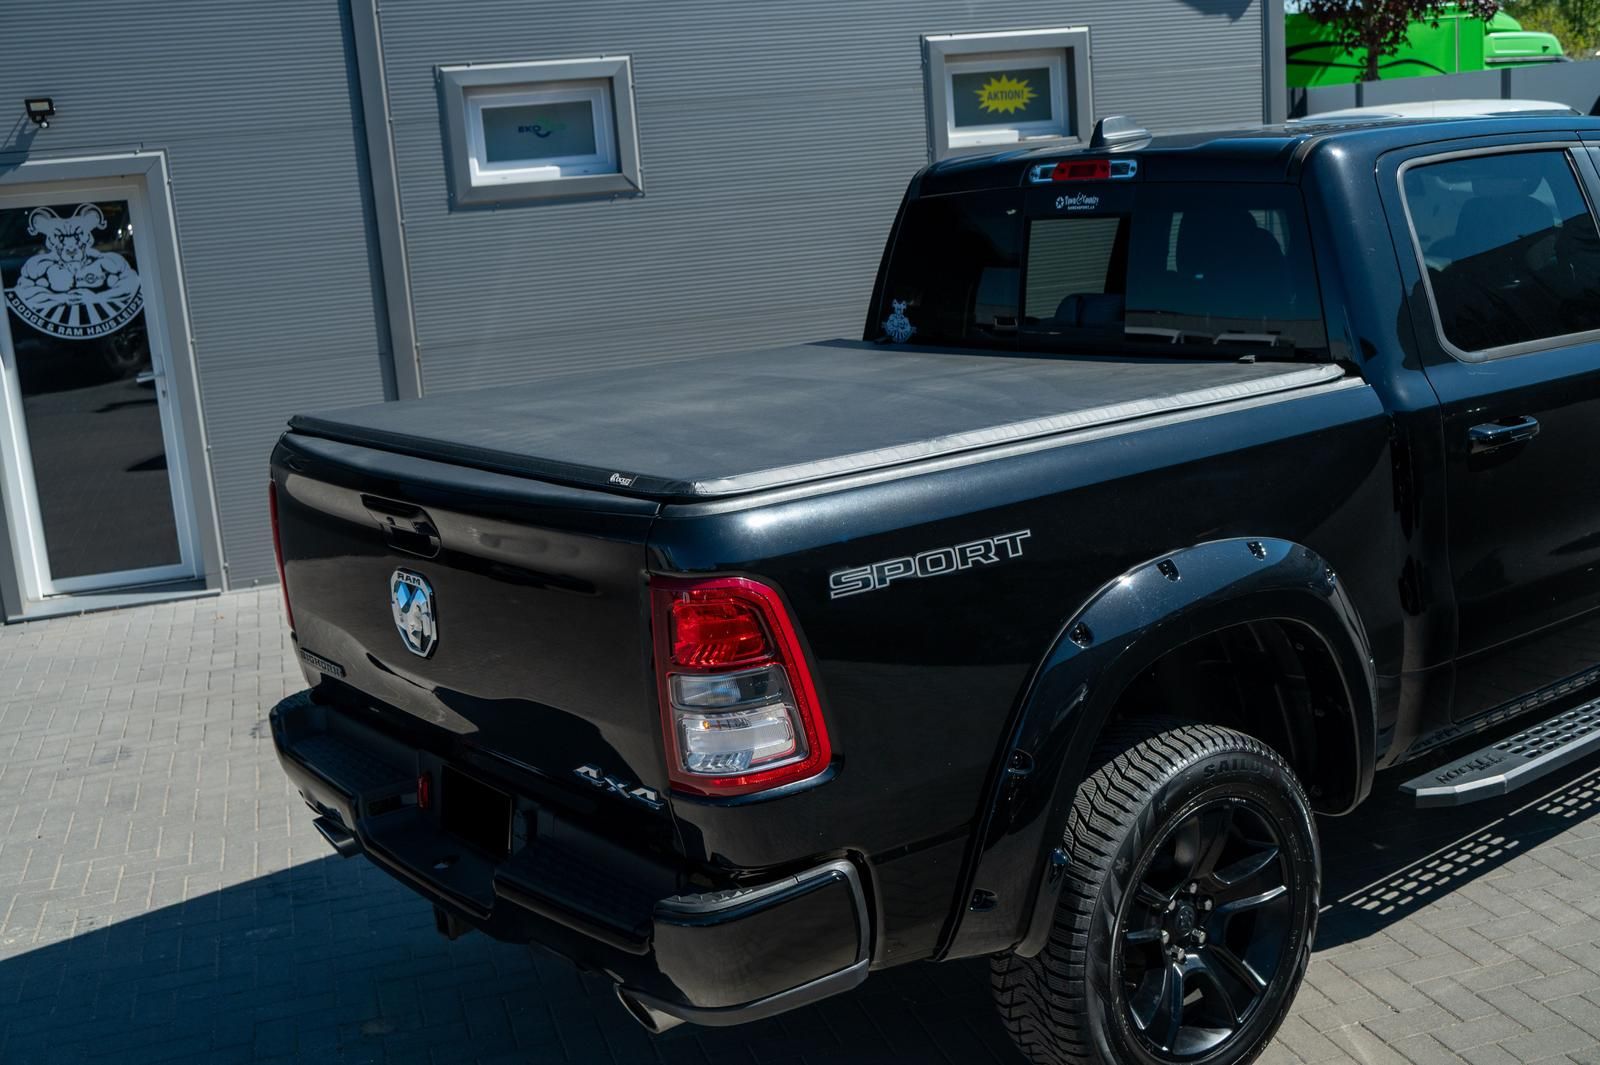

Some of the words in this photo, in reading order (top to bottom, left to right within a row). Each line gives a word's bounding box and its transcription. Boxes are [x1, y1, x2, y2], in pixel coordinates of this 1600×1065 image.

[987, 89, 1024, 101] AKTION!
[12, 298, 47, 326] DODGE
[47, 323, 54, 331] &
[58, 326, 83, 336] RAM
[87, 320, 117, 335] HAUS
[119, 291, 143, 322] LEIPZI
[829, 528, 1031, 599] SPORT
[397, 572, 421, 586] RAM
